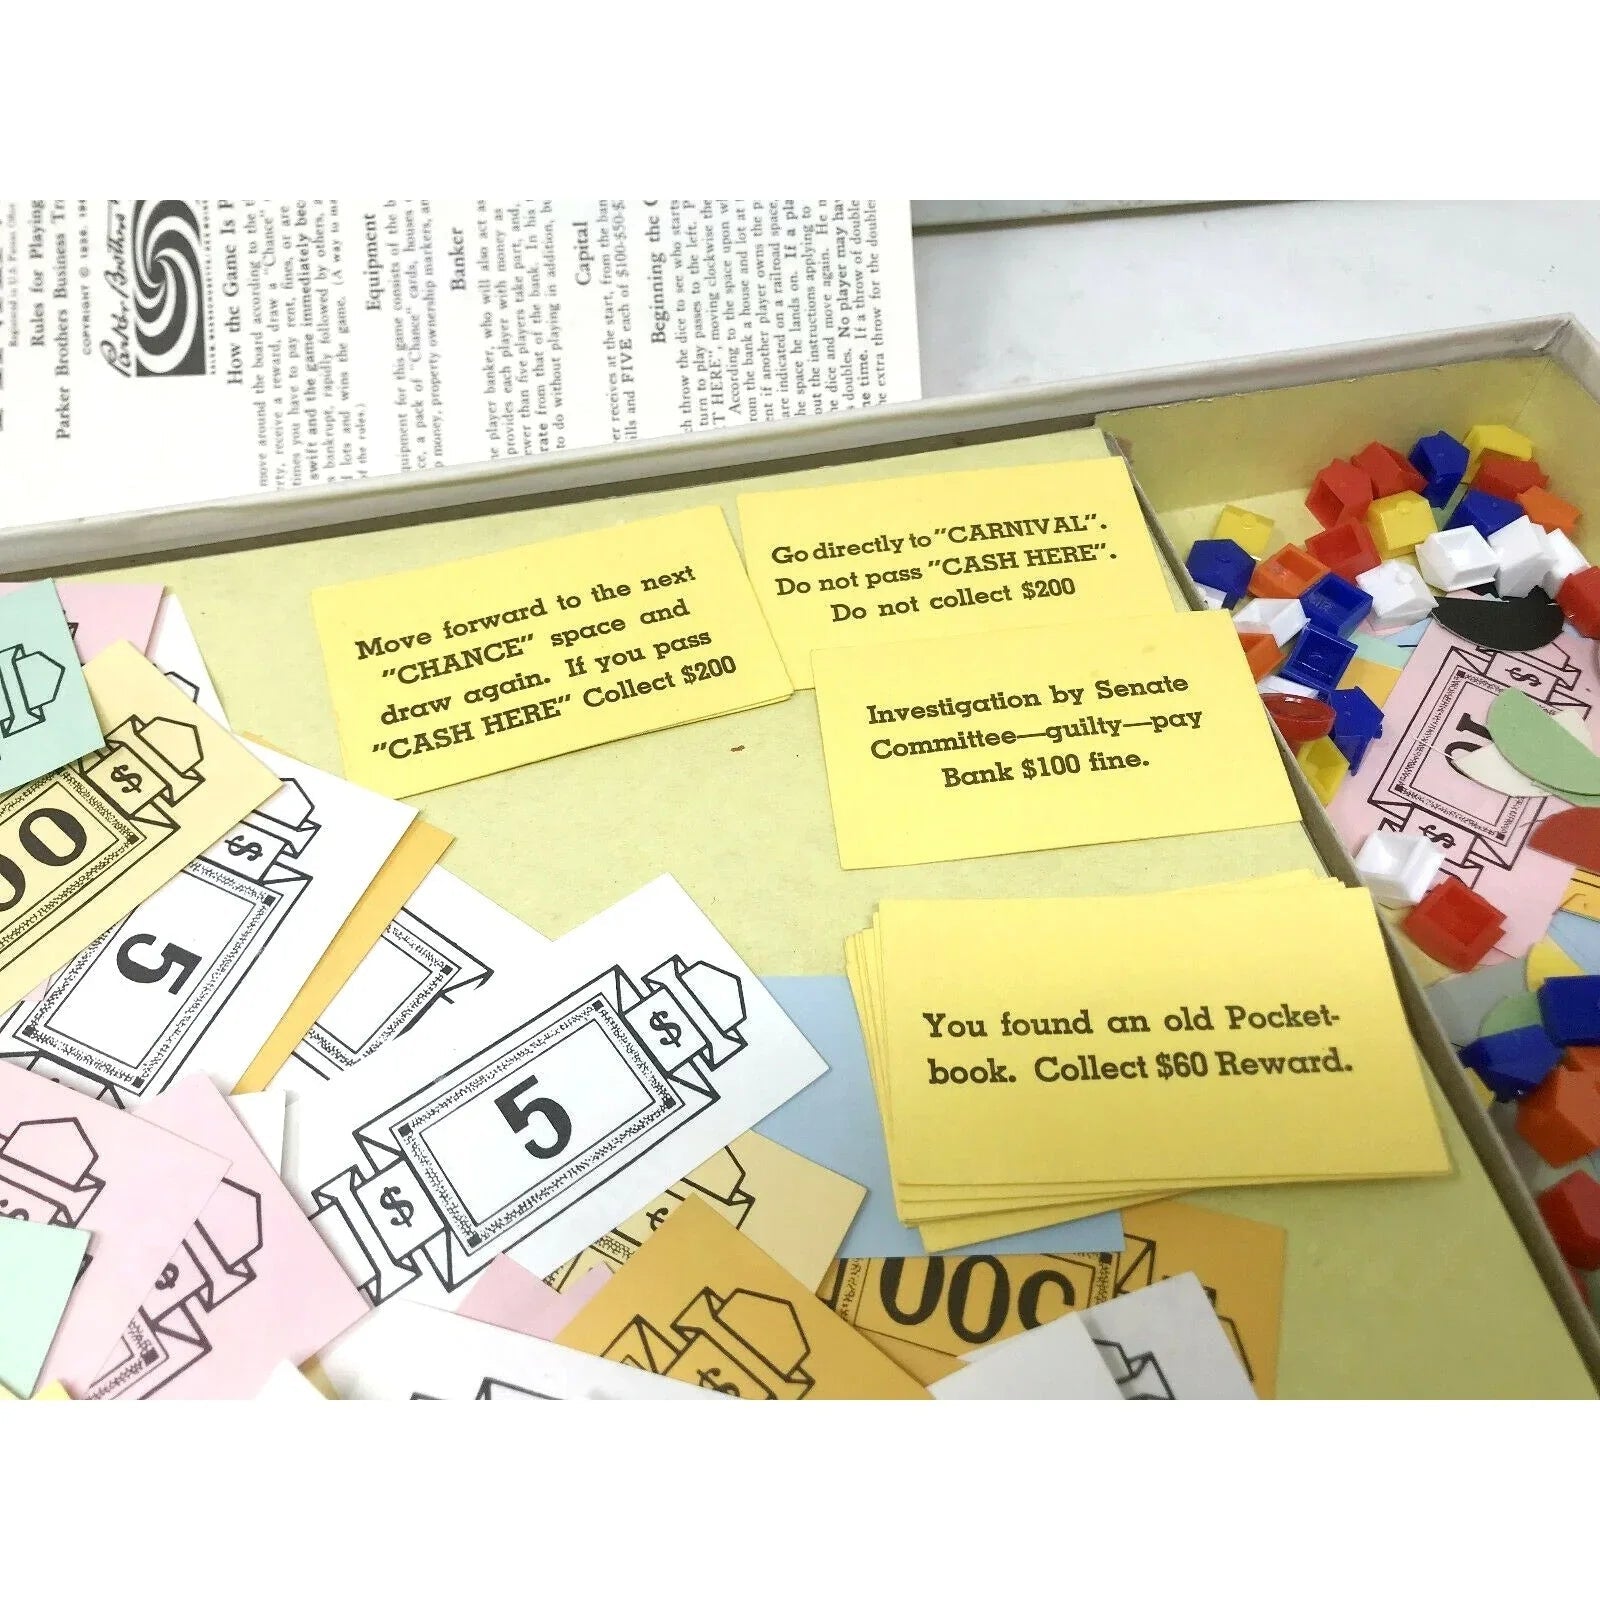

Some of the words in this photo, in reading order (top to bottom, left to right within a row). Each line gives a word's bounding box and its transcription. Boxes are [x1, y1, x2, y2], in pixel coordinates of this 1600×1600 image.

[27, 200, 45, 260] Playing
[219, 219, 237, 235] Is
[401, 209, 417, 253] houses
[644, 215, 661, 243] the
[721, 221, 733, 254] upon
[52, 232, 69, 299] Business
[222, 244, 240, 298] Game
[362, 213, 386, 311] Equipment
[447, 227, 467, 291] Banker
[495, 229, 507, 272] money
[571, 221, 596, 286] Capital
[598, 253, 613, 285] from
[701, 225, 717, 288] clockwise
[754, 243, 766, 279] owns
[767, 242, 784, 294] railroad
[799, 223, 817, 282] applying
[28, 269, 45, 294] for
[246, 260, 264, 325] according
[295, 232, 314, 328] immediately
[387, 261, 403, 312] consists
[493, 279, 509, 310] with
[510, 275, 526, 303] take
[647, 252, 670, 344] Beginning
[722, 260, 737, 295] space
[737, 279, 752, 317] house
[835, 263, 853, 312] player
[851, 268, 866, 310] throw
[29, 302, 47, 347] Rules
[223, 306, 241, 333] the
[314, 288, 332, 345] followed
[421, 280, 439, 348] ownership
[616, 303, 632, 332] each
[692, 300, 707, 339] passes
[705, 291, 721, 341] moving
[754, 283, 771, 324] player
[786, 296, 802, 333] lands
[804, 285, 820, 363] instructions
[823, 293, 835, 329] move
[53, 308, 71, 377] Brothers
[496, 317, 514, 358] player
[513, 308, 530, 355] players
[545, 303, 563, 351] playing
[673, 317, 688, 344] dice
[869, 306, 885, 347] throw
[226, 342, 244, 385] How
[248, 331, 265, 369] board
[531, 351, 546, 378] that
[618, 337, 635, 384] FIVE
[691, 345, 709, 373] play
[739, 334, 755, 366] bank
[756, 330, 772, 380] another
[772, 334, 789, 393] indicated
[875, 352, 887, 387] extra
[316, 352, 335, 398] rapidly
[428, 352, 443, 407] property
[514, 360, 529, 384] five
[548, 357, 563, 409] without
[725, 347, 742, 415] According
[794, 360, 808, 395] space
[824, 366, 839, 393] dice
[54, 386, 71, 440] Parker
[516, 389, 531, 419] than
[533, 384, 548, 416] from
[605, 372, 621, 422] receives
[677, 374, 693, 415] throw
[698, 397, 710, 427] turn
[252, 400, 268, 447] around
[274, 411, 285, 455] receive
[485, 400, 501, 441] player
[500, 399, 519, 456] provides
[537, 423, 550, 453] rate
[291, 452, 302, 487] times
[771, 545, 809, 565] Go
[812, 534, 905, 560] directly
[908, 533, 932, 549] to
[774, 577, 812, 596] Do
[818, 571, 860, 592] not
[864, 567, 923, 590] pass
[829, 603, 868, 623] Do
[877, 595, 920, 618] not
[929, 584, 1013, 610] collect
[1020, 577, 1076, 601] $200
[354, 631, 432, 661] Move
[442, 597, 549, 640] forward
[556, 594, 582, 611] to
[590, 583, 632, 603] the
[640, 565, 697, 592] next
[550, 618, 627, 648] space
[639, 597, 691, 625] and
[380, 695, 452, 726] draw
[463, 672, 551, 704] again.
[564, 655, 588, 678] If
[593, 647, 647, 674] you
[652, 631, 713, 661] pass
[582, 671, 677, 708] Collect
[680, 655, 737, 686] $200
[866, 691, 1043, 725] Investigation
[1048, 684, 1085, 706] by
[1094, 675, 1189, 700] Senate
[940, 761, 1015, 788] Bank
[1020, 753, 1081, 781] $100
[1088, 751, 1150, 772] fine.
[116, 933, 203, 995] 5
[649, 1010, 682, 1048] $
[922, 1012, 989, 1039] You
[1000, 1008, 1094, 1037] found
[1107, 1014, 1152, 1034] an
[1163, 1005, 1215, 1032] old
[1224, 1003, 1340, 1031] Pocket-
[926, 1057, 1017, 1085] book.
[1034, 1054, 1149, 1083] Collect
[1155, 1051, 1209, 1081] $60
[1214, 1046, 1354, 1077] Reward.
[494, 1075, 573, 1160] 5
[380, 1186, 415, 1228] $
